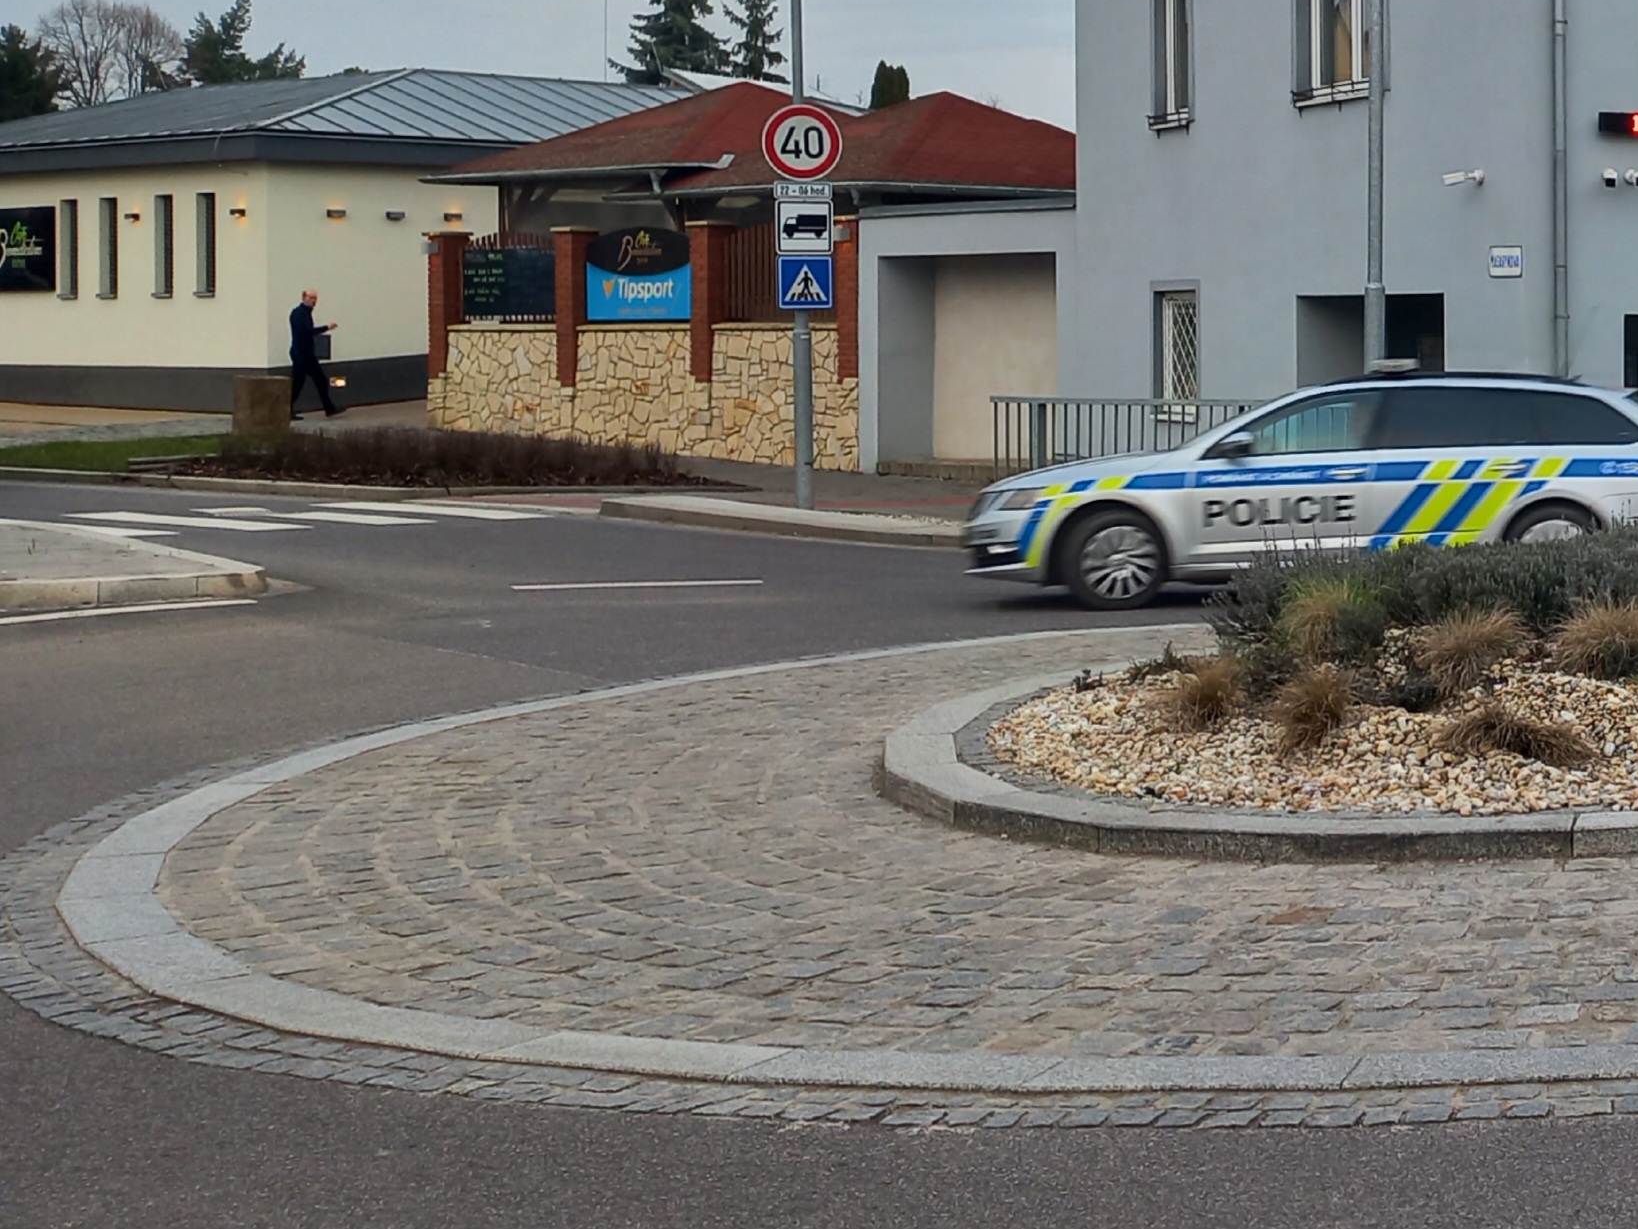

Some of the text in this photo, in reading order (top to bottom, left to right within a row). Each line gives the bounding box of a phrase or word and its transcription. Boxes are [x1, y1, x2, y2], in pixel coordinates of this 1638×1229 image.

[780, 125, 824, 160] 40
[780, 185, 789, 196] 22
[617, 277, 674, 303] Tipsport
[1203, 494, 1356, 528] POLICIE
